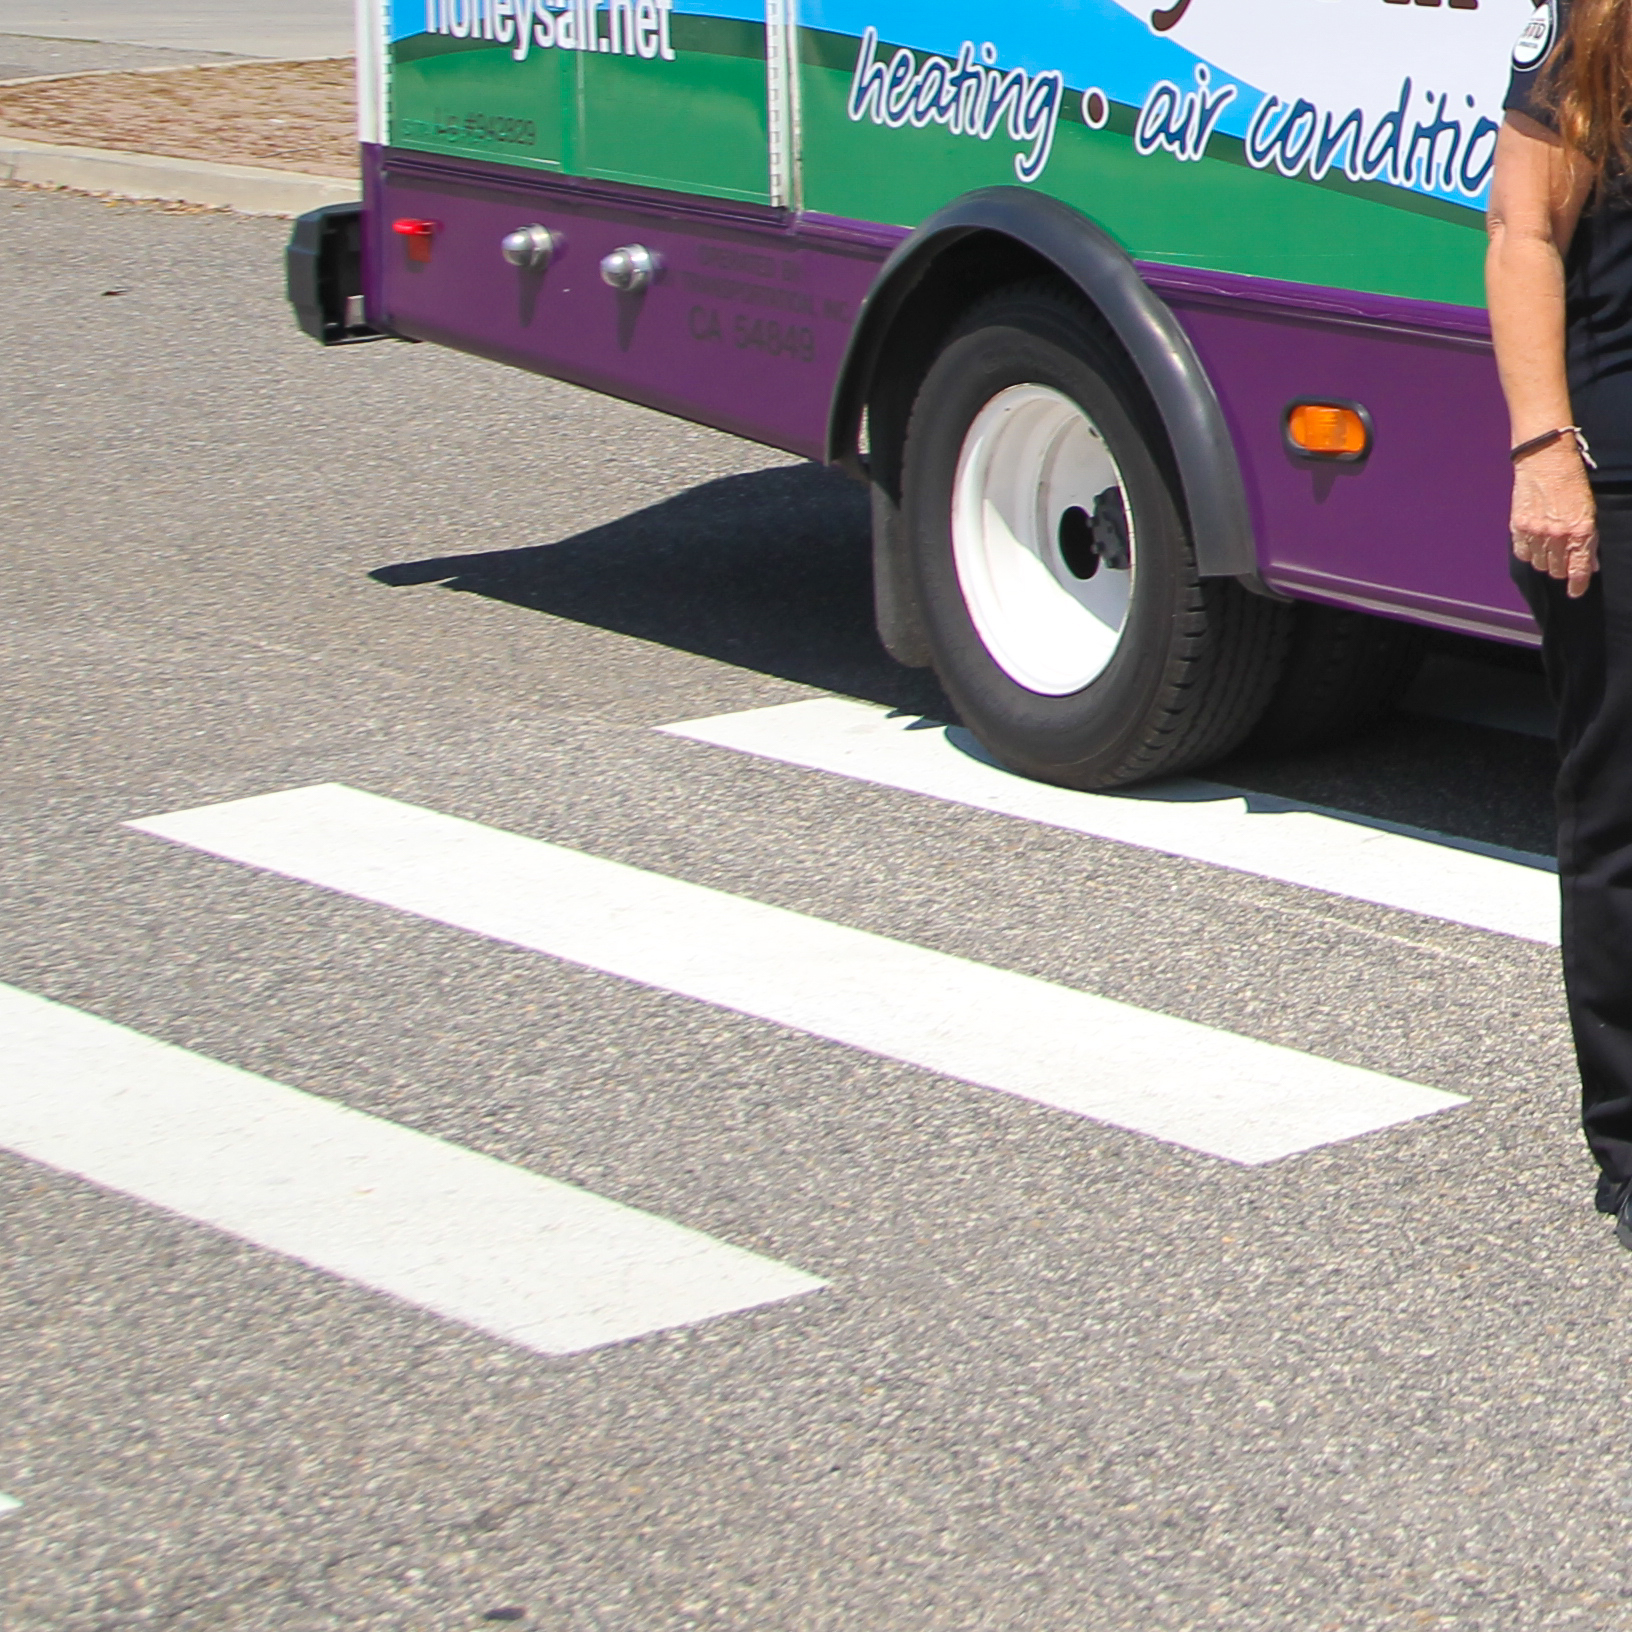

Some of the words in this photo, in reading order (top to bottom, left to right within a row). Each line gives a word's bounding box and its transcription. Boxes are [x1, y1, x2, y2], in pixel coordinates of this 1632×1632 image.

[848, 25, 1064, 183] heating
[1136, 63, 1238, 162] air
[688, 305, 722, 342] CA
[733, 314, 816, 363] 54849
